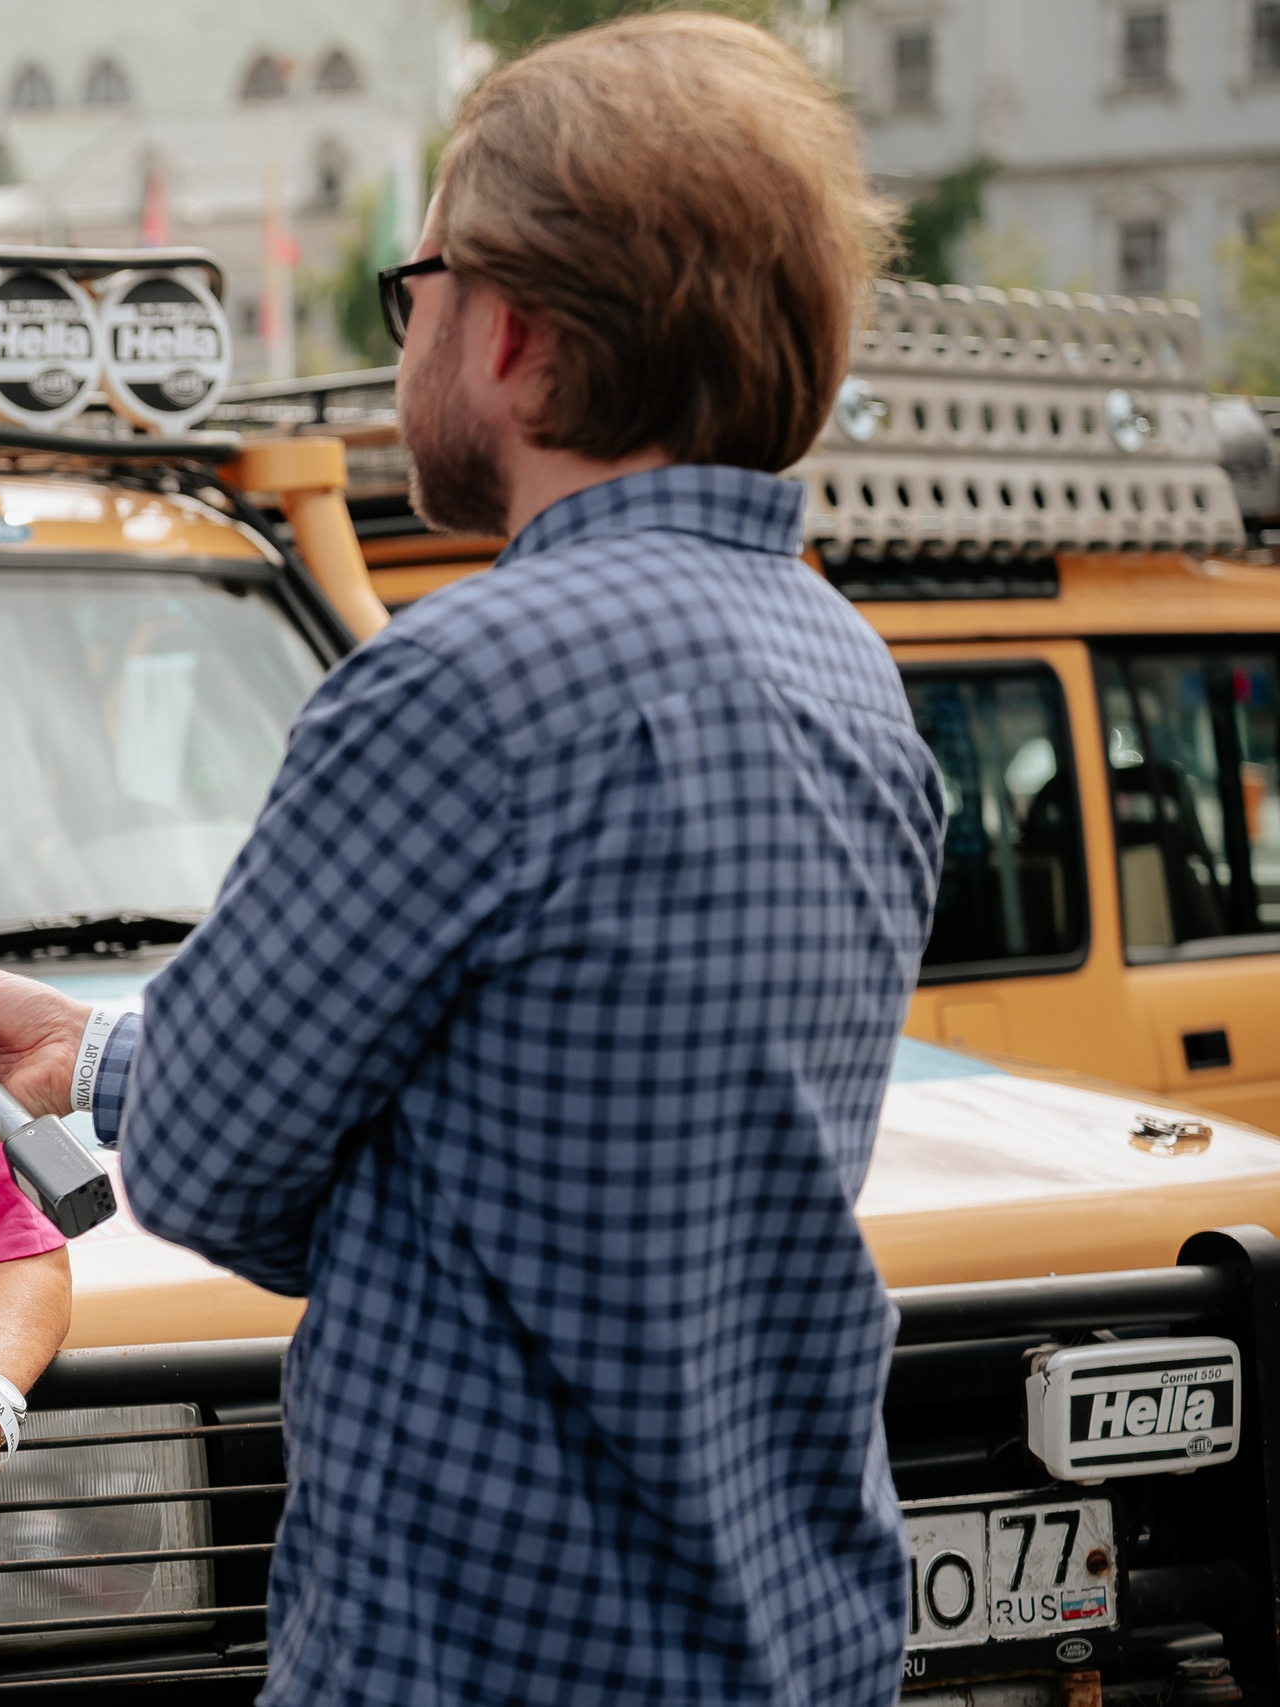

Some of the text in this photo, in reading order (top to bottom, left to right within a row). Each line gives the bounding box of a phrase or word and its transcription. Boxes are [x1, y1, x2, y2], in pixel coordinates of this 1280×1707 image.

[116, 325, 219, 361] Hella
[1160, 1368, 1222, 1385] Comet 550
[1087, 1385, 1216, 1441] Hella
[999, 1510, 1081, 1592] 77
[996, 1594, 1058, 1626] RUS
